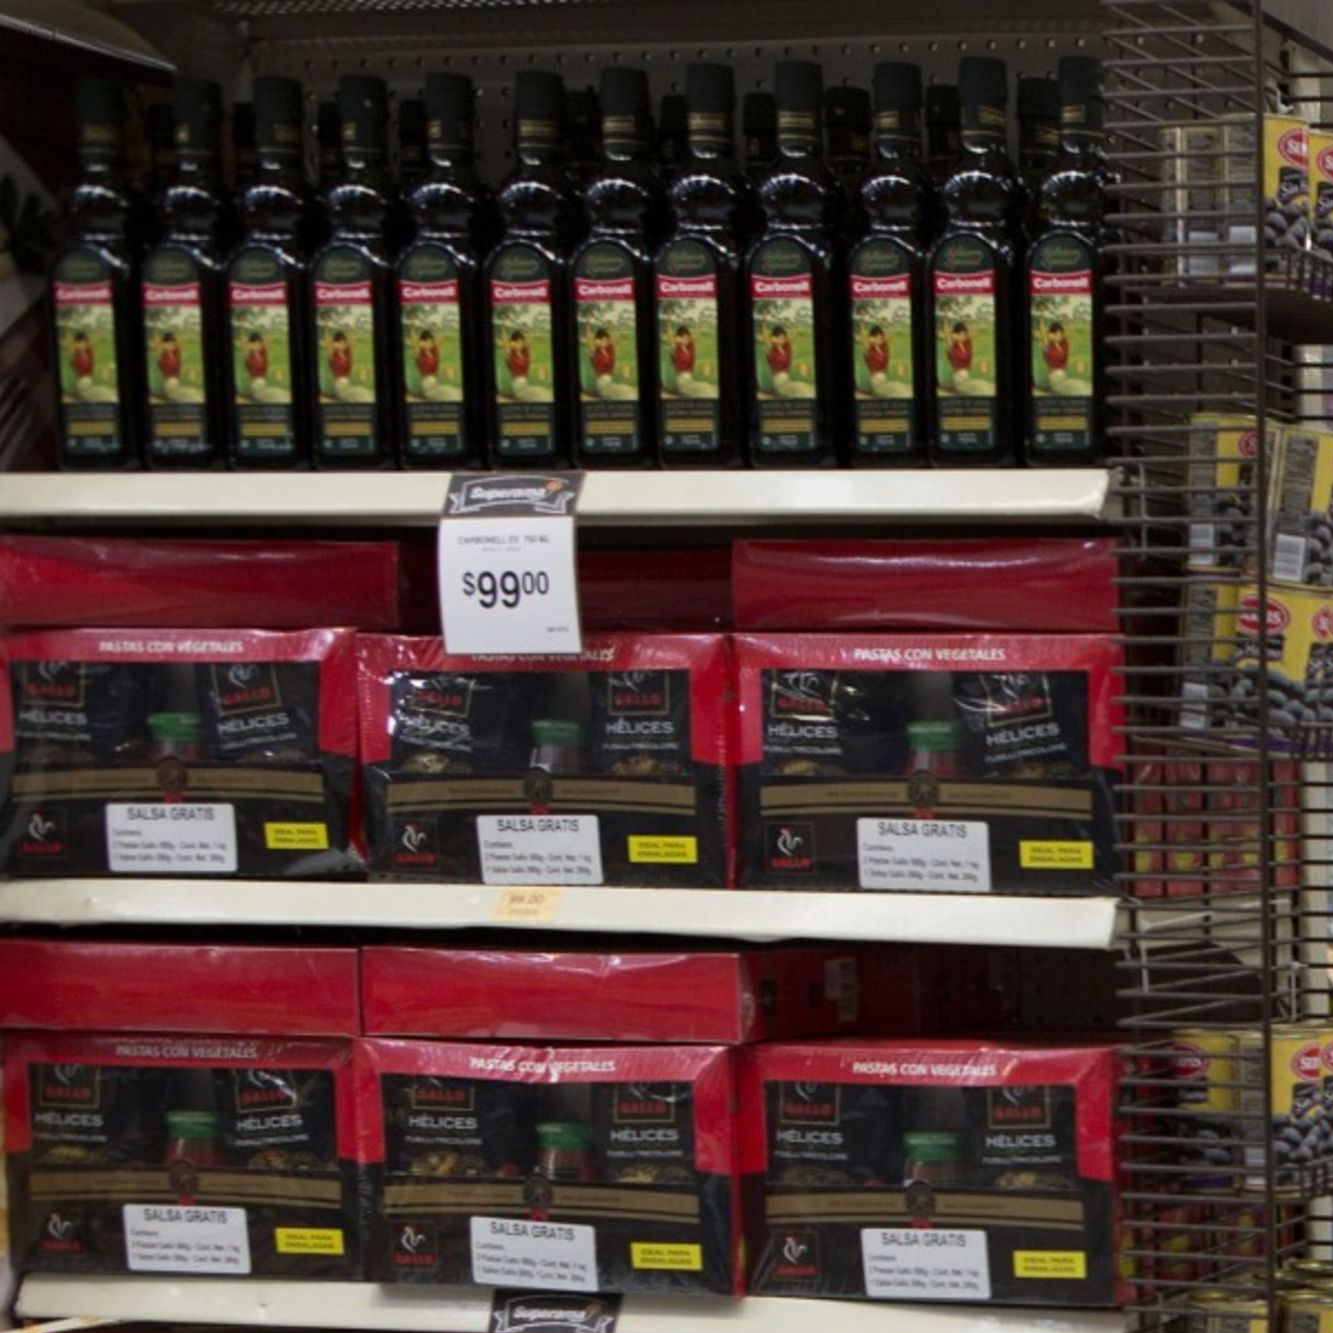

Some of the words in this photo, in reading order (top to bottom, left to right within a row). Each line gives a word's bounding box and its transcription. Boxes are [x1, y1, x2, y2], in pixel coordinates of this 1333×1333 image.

[660, 281, 714, 293] Carbonell
[754, 281, 809, 293] Carbonell
[853, 281, 908, 293] Carbonell
[937, 277, 991, 289] Carbonell
[1033, 277, 1088, 289] Carbonell
[494, 286, 547, 298] Carbonell
[579, 284, 632, 296] Carbonell
[470, 486, 547, 501] Superama
[458, 535, 506, 545] CARBONELL
[854, 648, 902, 661] PASTAS
[905, 649, 932, 661] CON
[936, 649, 1006, 662] VEGETALES
[606, 718, 675, 734] HÉLICES
[768, 722, 839, 738] HÉLICES
[128, 808, 168, 821] SALSA
[171, 808, 214, 821] GRATIS
[497, 819, 536, 832] SALSA
[537, 819, 580, 832] GRATIS
[878, 823, 919, 836] SALSA
[922, 824, 967, 838] GRATIS
[143, 1209, 182, 1223] SALSA
[185, 1211, 227, 1225] GRATIS
[490, 1221, 529, 1236] SALSA
[531, 1225, 575, 1242] GRATIS
[882, 1232, 920, 1246] SALSA
[923, 1233, 966, 1248] GRATIS
[513, 1306, 586, 1323] Superama
